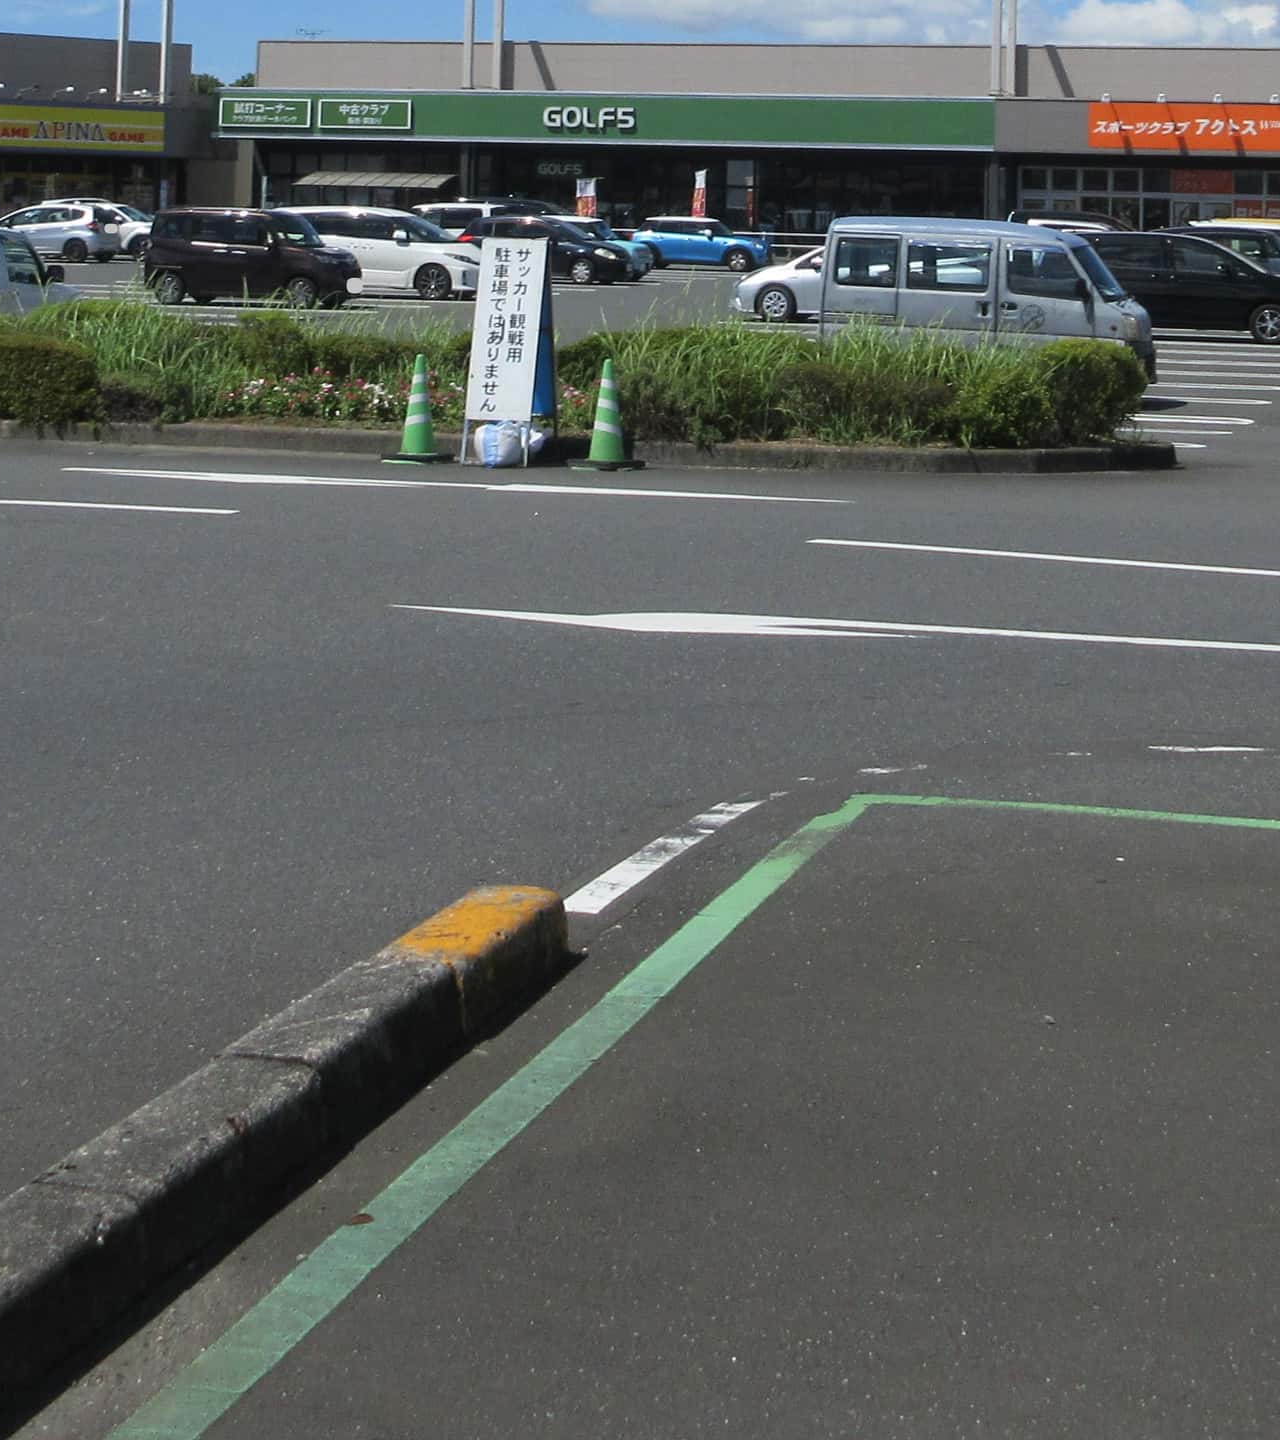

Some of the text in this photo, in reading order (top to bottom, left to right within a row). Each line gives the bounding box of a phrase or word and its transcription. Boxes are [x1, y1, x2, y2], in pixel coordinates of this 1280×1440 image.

[233, 102, 296, 115] 試打コーナー
[338, 103, 390, 116] 中古クラブ
[542, 106, 635, 129] GOLF5
[33, 120, 107, 142] APINA
[109, 131, 145, 143] GAME
[1093, 120, 1191, 135] スポーツクラブ
[1194, 118, 1259, 136] アクトス
[537, 163, 583, 176] GOLF5
[505, 247, 532, 364] サッカー観戦用
[479, 246, 512, 413] 駐車場ではありません
